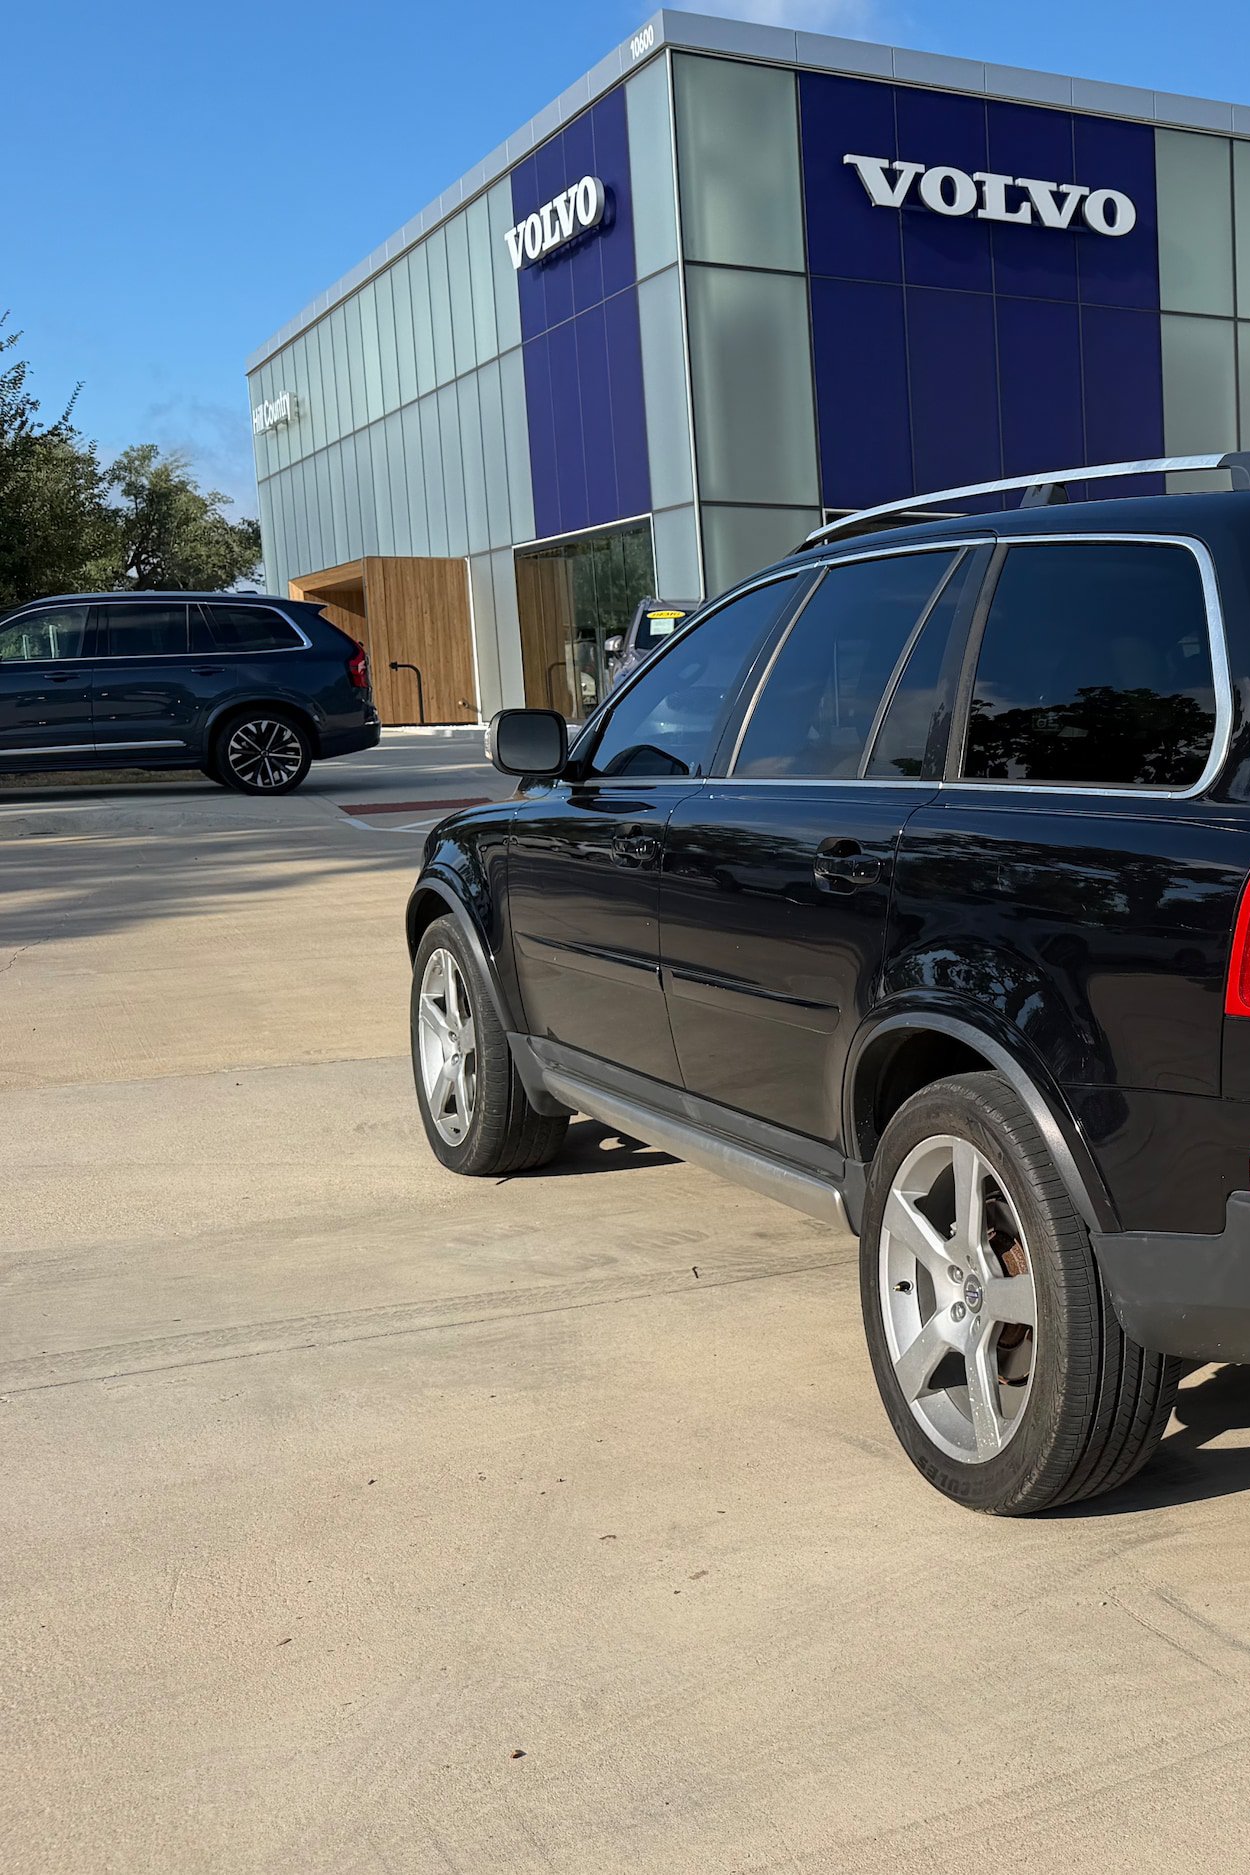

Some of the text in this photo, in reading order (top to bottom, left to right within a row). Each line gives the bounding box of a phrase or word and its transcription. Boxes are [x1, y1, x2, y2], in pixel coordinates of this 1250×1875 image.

[630, 24, 654, 60] 10600
[503, 175, 600, 270] VOLVO
[843, 154, 1136, 237] VOLVO
[263, 390, 291, 427] Country
